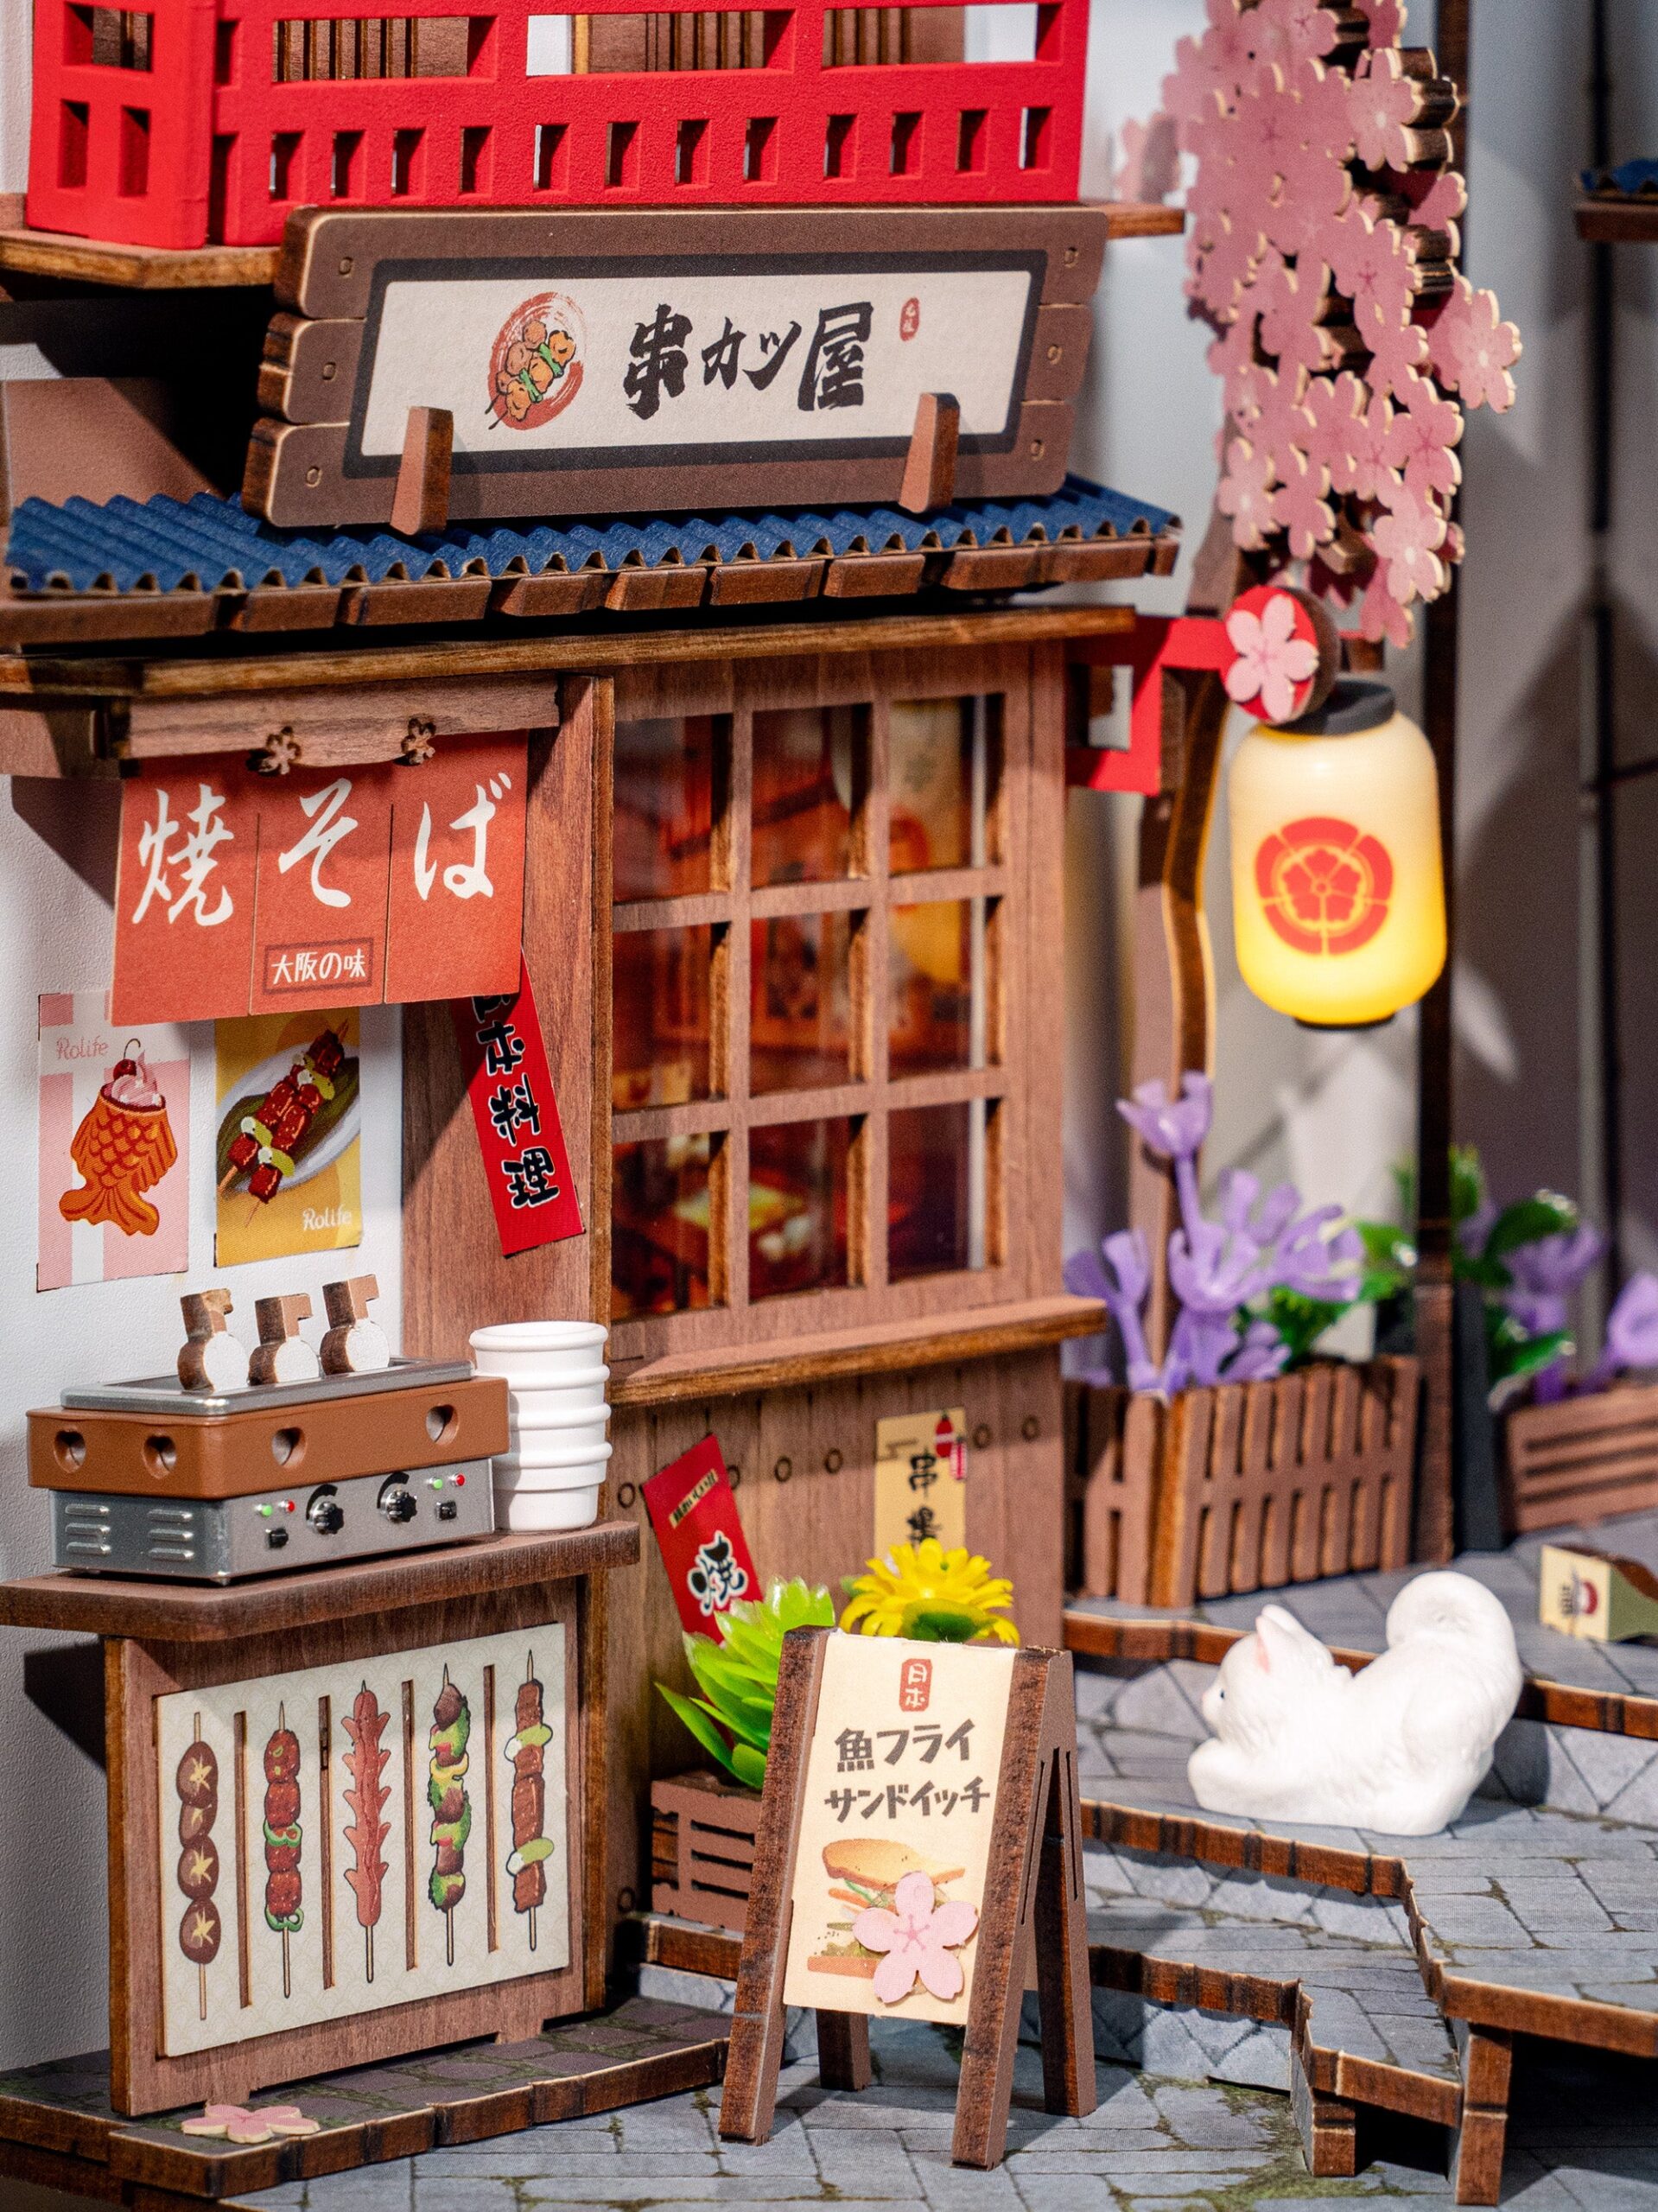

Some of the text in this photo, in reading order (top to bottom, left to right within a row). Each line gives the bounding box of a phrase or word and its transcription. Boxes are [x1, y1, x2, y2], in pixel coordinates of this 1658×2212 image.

[624, 302, 873, 420] 串カツ屋
[131, 772, 511, 927] 焼そば
[271, 949, 366, 985] 大阪の味
[56, 1035, 110, 1060] Rolife
[303, 1204, 352, 1231] Rolife
[689, 1531, 747, 1614] 焼
[905, 1663, 928, 1708] 日本
[834, 1719, 976, 1772] 魚フライ
[823, 1776, 991, 1823] サンドイッチ
